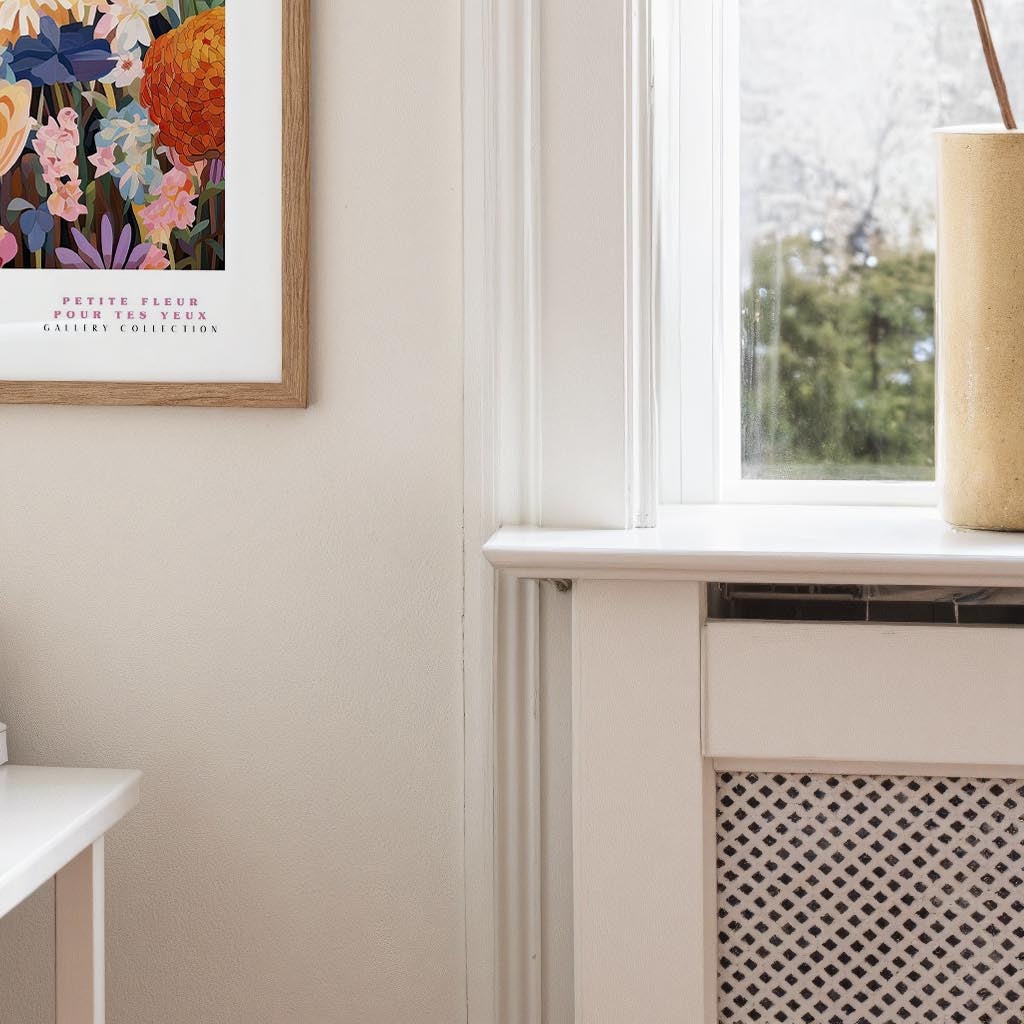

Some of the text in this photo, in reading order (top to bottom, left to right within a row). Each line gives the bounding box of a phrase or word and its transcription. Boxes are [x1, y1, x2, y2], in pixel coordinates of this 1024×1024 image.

[62, 296, 199, 307] PETITE FLEUR
[53, 310, 207, 321] POUR TES YEUX
[42, 323, 219, 334] GALLERY COLLECTION
